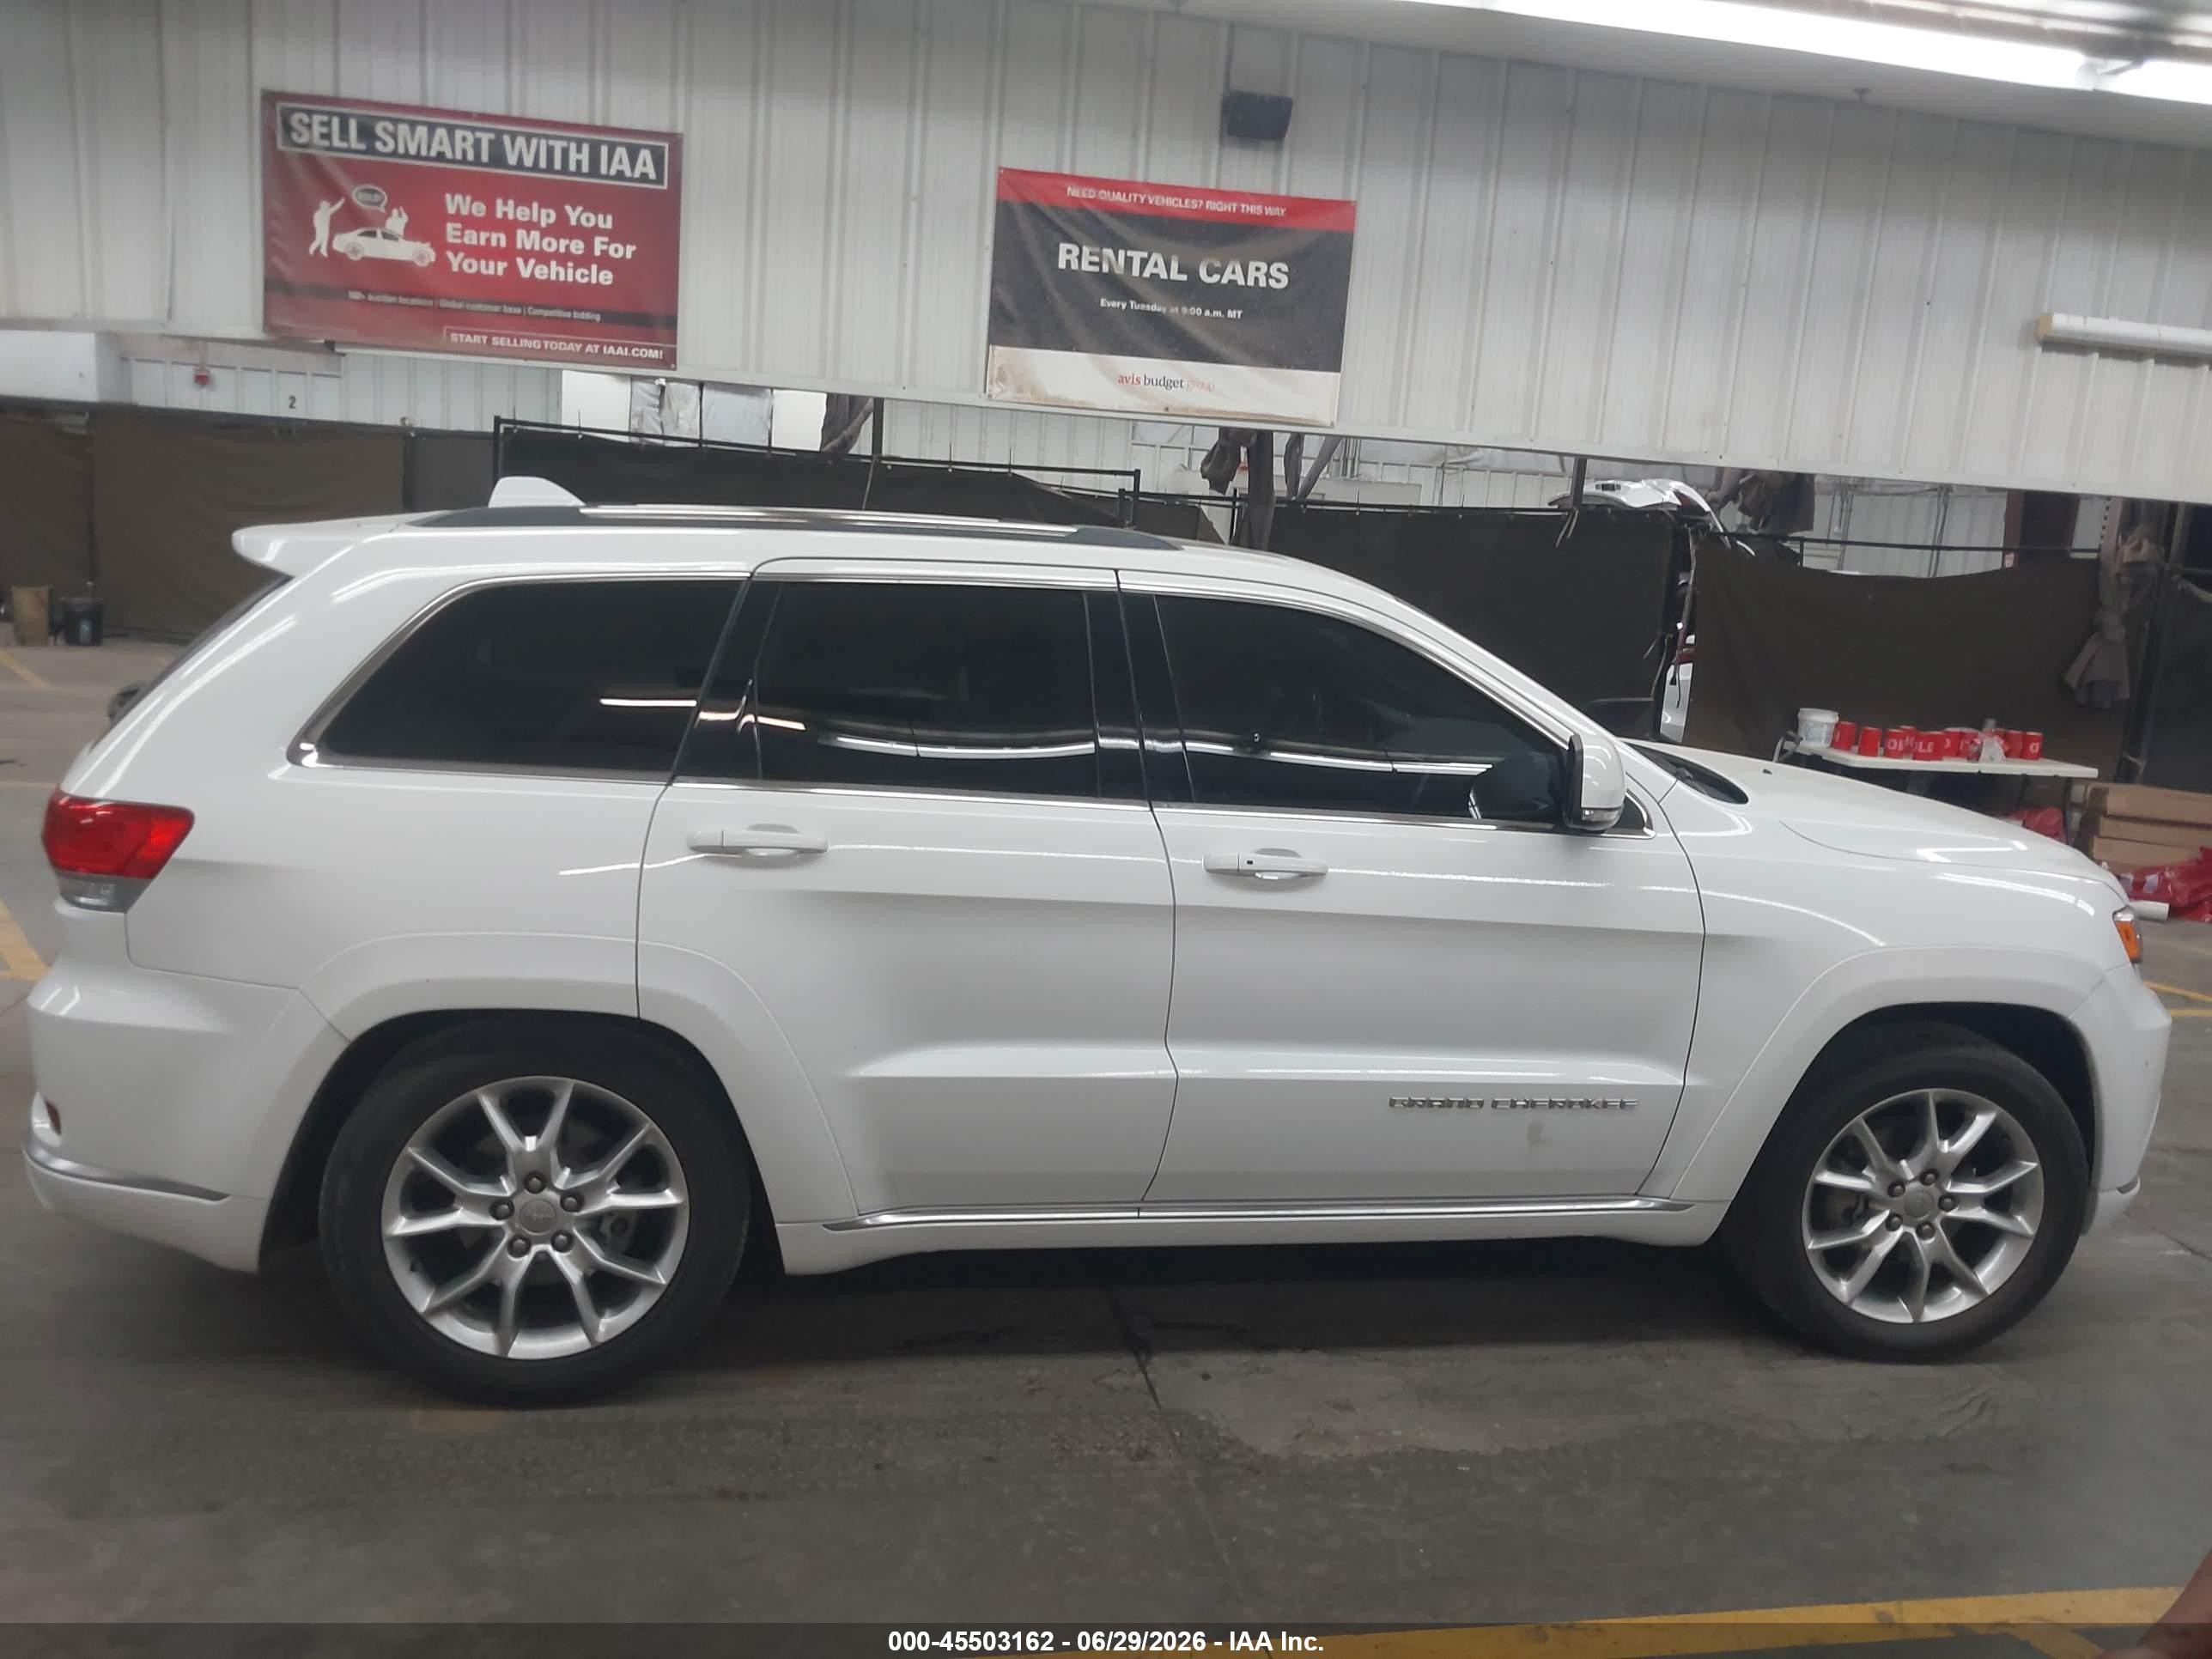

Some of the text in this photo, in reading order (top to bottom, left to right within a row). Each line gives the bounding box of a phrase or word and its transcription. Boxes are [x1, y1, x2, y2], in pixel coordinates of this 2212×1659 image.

[289, 112, 658, 180] SELL SMART WITH IAA
[445, 192, 614, 229] We Help You
[1066, 185, 1287, 216] NEED QUALITY VEHICLES? RIGHT THIS WAY
[446, 222, 636, 259] Earn More For
[446, 250, 614, 285] Your Vehicle
[1057, 242, 1290, 289] RENTAL CARS
[1100, 298, 1127, 311] Every
[1129, 300, 1167, 314] Tuesday
[1182, 306, 1202, 316] 9:00
[1204, 309, 1224, 319] a.m.
[1227, 309, 1243, 319] MT
[450, 333, 664, 359] START SELLING TODAY AT IAAI.COM!
[1117, 373, 1141, 386] avis
[1143, 374, 1184, 391] budget
[289, 395, 296, 410] 2
